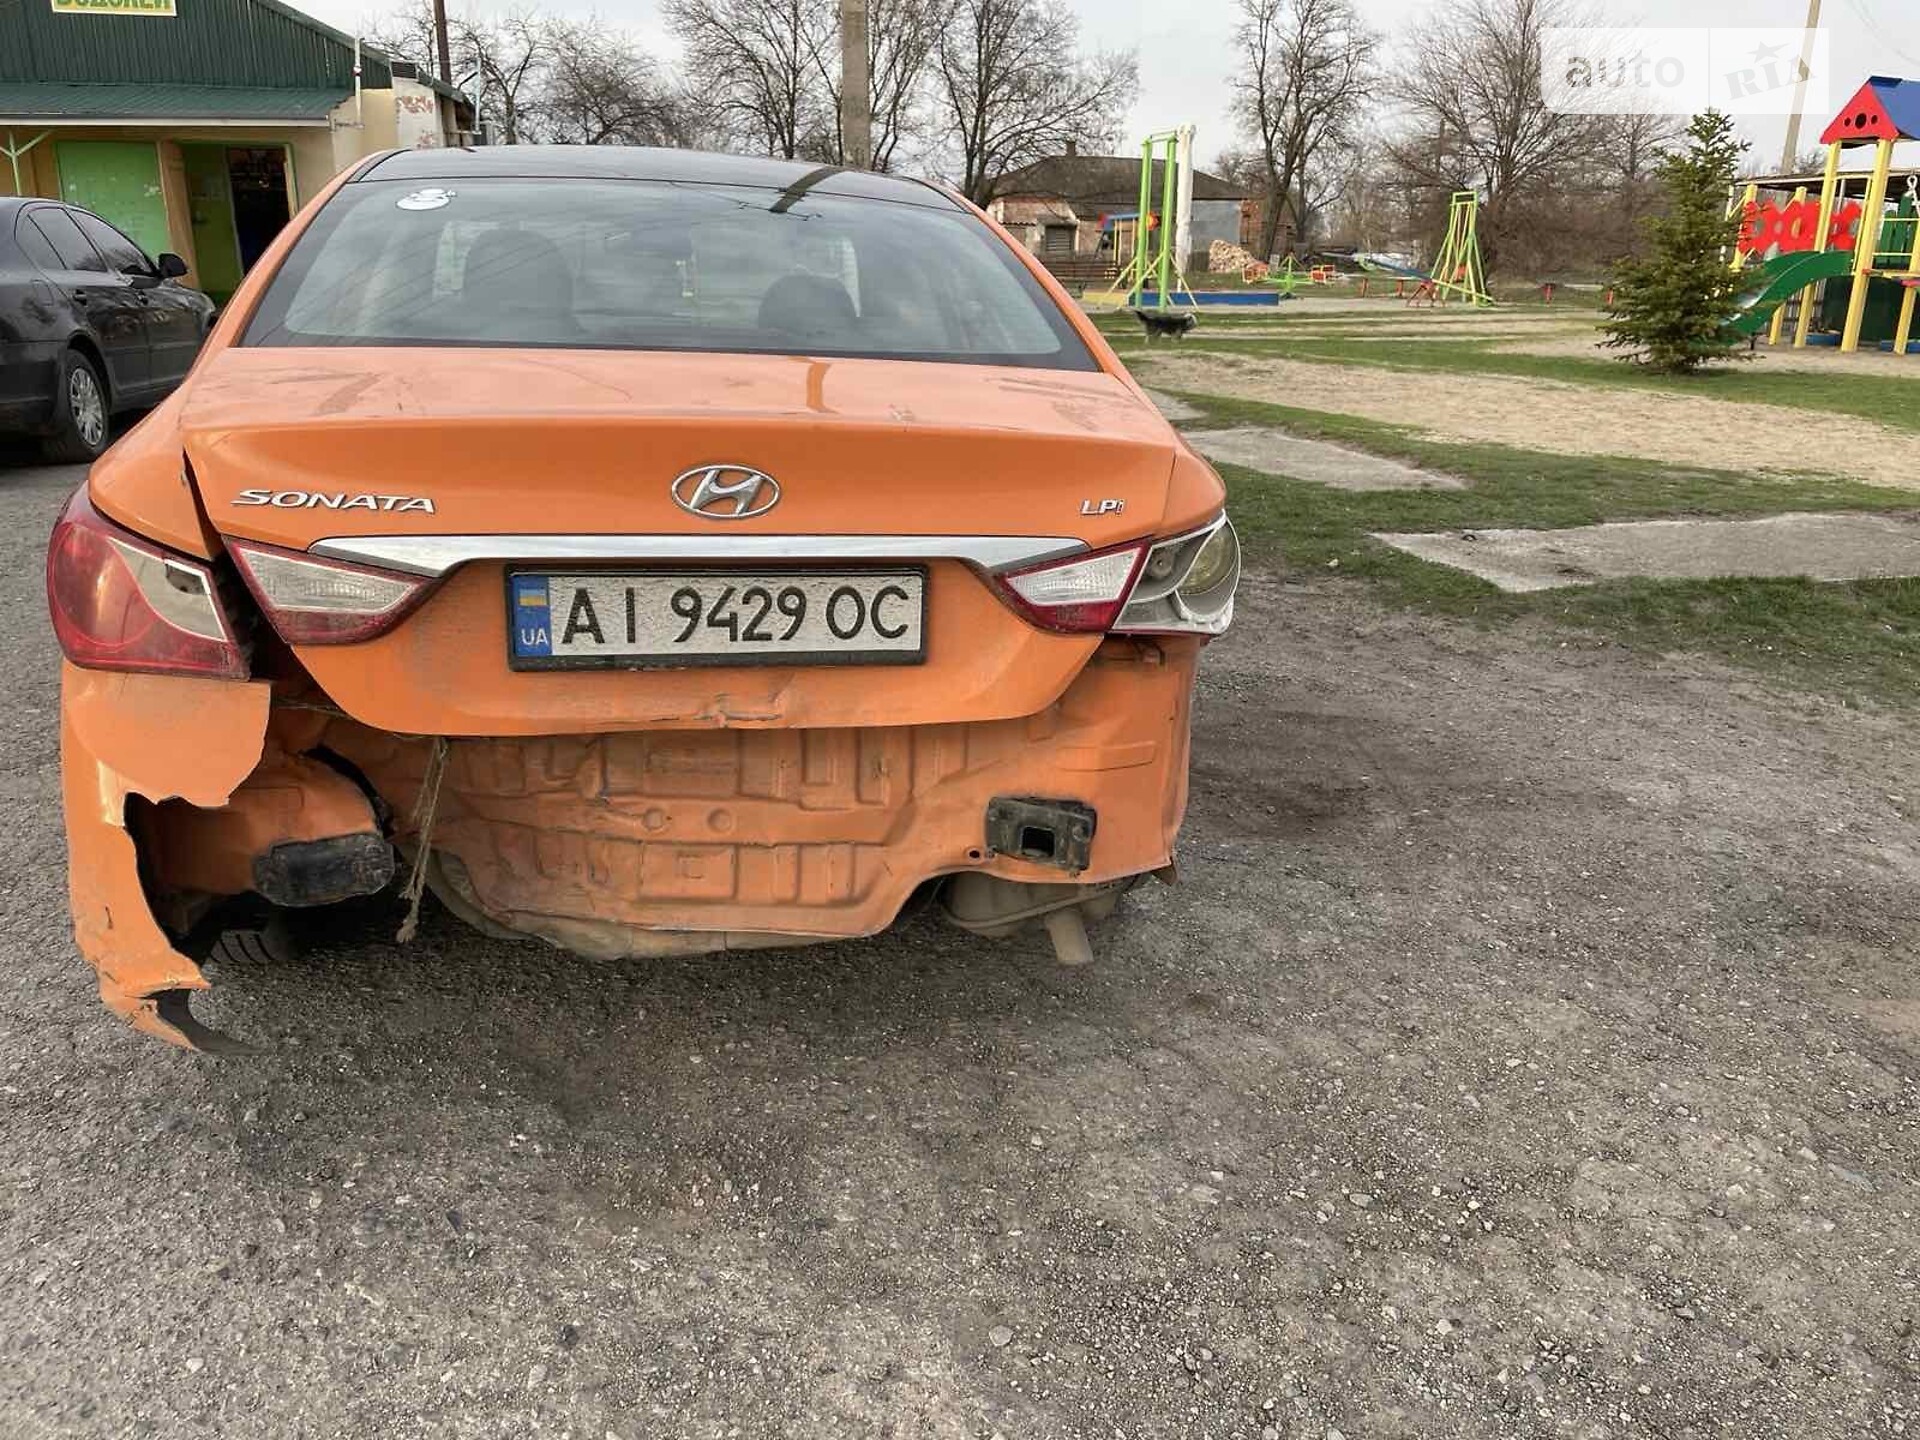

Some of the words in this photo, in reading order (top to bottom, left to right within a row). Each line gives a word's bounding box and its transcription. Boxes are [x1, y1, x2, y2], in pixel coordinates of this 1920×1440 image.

[231, 489, 436, 514] SONATA
[1081, 499, 1124, 516] LPi
[562, 587, 635, 644] AI
[671, 585, 808, 643] 9429
[826, 585, 909, 640] OC
[521, 627, 549, 646] UA
